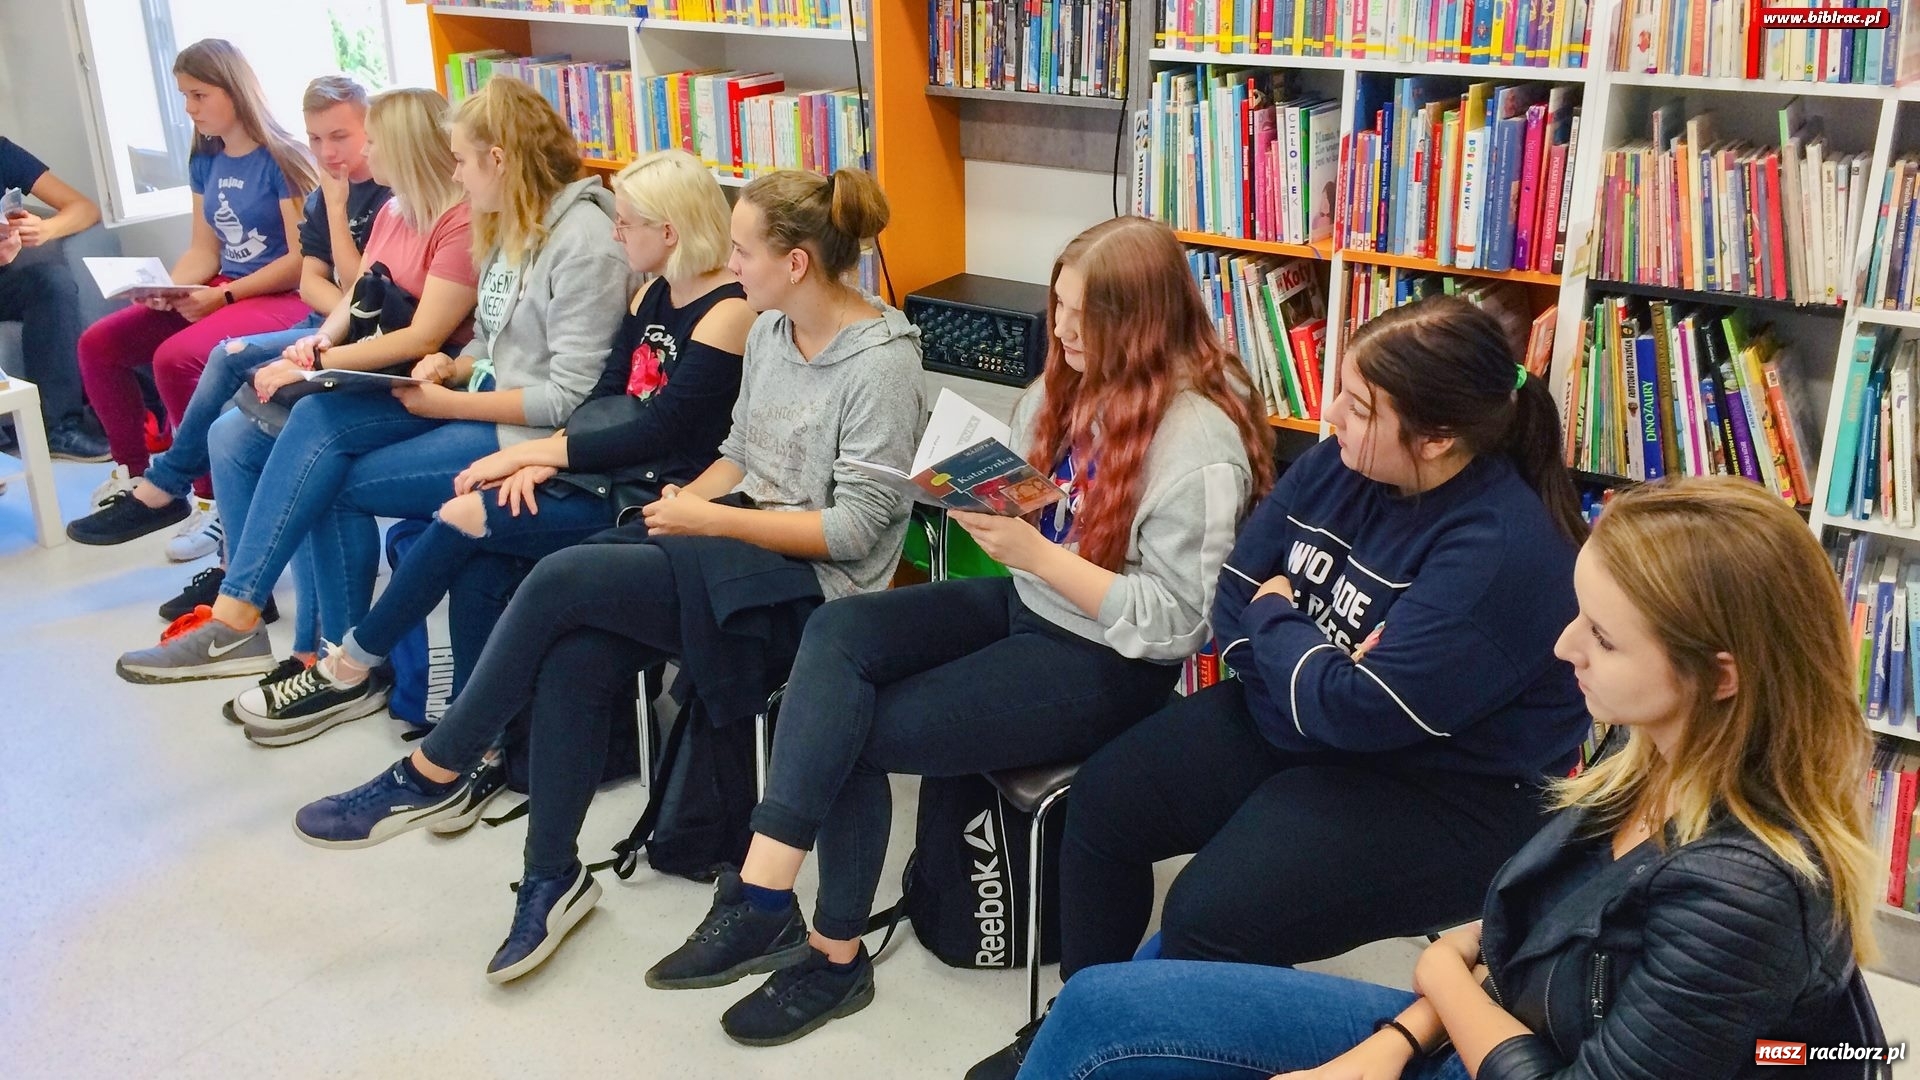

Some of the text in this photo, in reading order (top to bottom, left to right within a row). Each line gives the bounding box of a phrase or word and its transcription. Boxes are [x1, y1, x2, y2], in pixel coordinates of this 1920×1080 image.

[1902, 176, 1913, 204] Poradnik
[1546, 210, 1556, 240] LUDOWE
[1282, 264, 1313, 292] Koty
[1627, 370, 1636, 398] DINOZAURY
[1642, 381, 1657, 442] DINOZAURY
[957, 455, 1015, 485] Katarynka
[425, 648, 454, 711] PUMA
[970, 854, 1006, 967] Reebok
